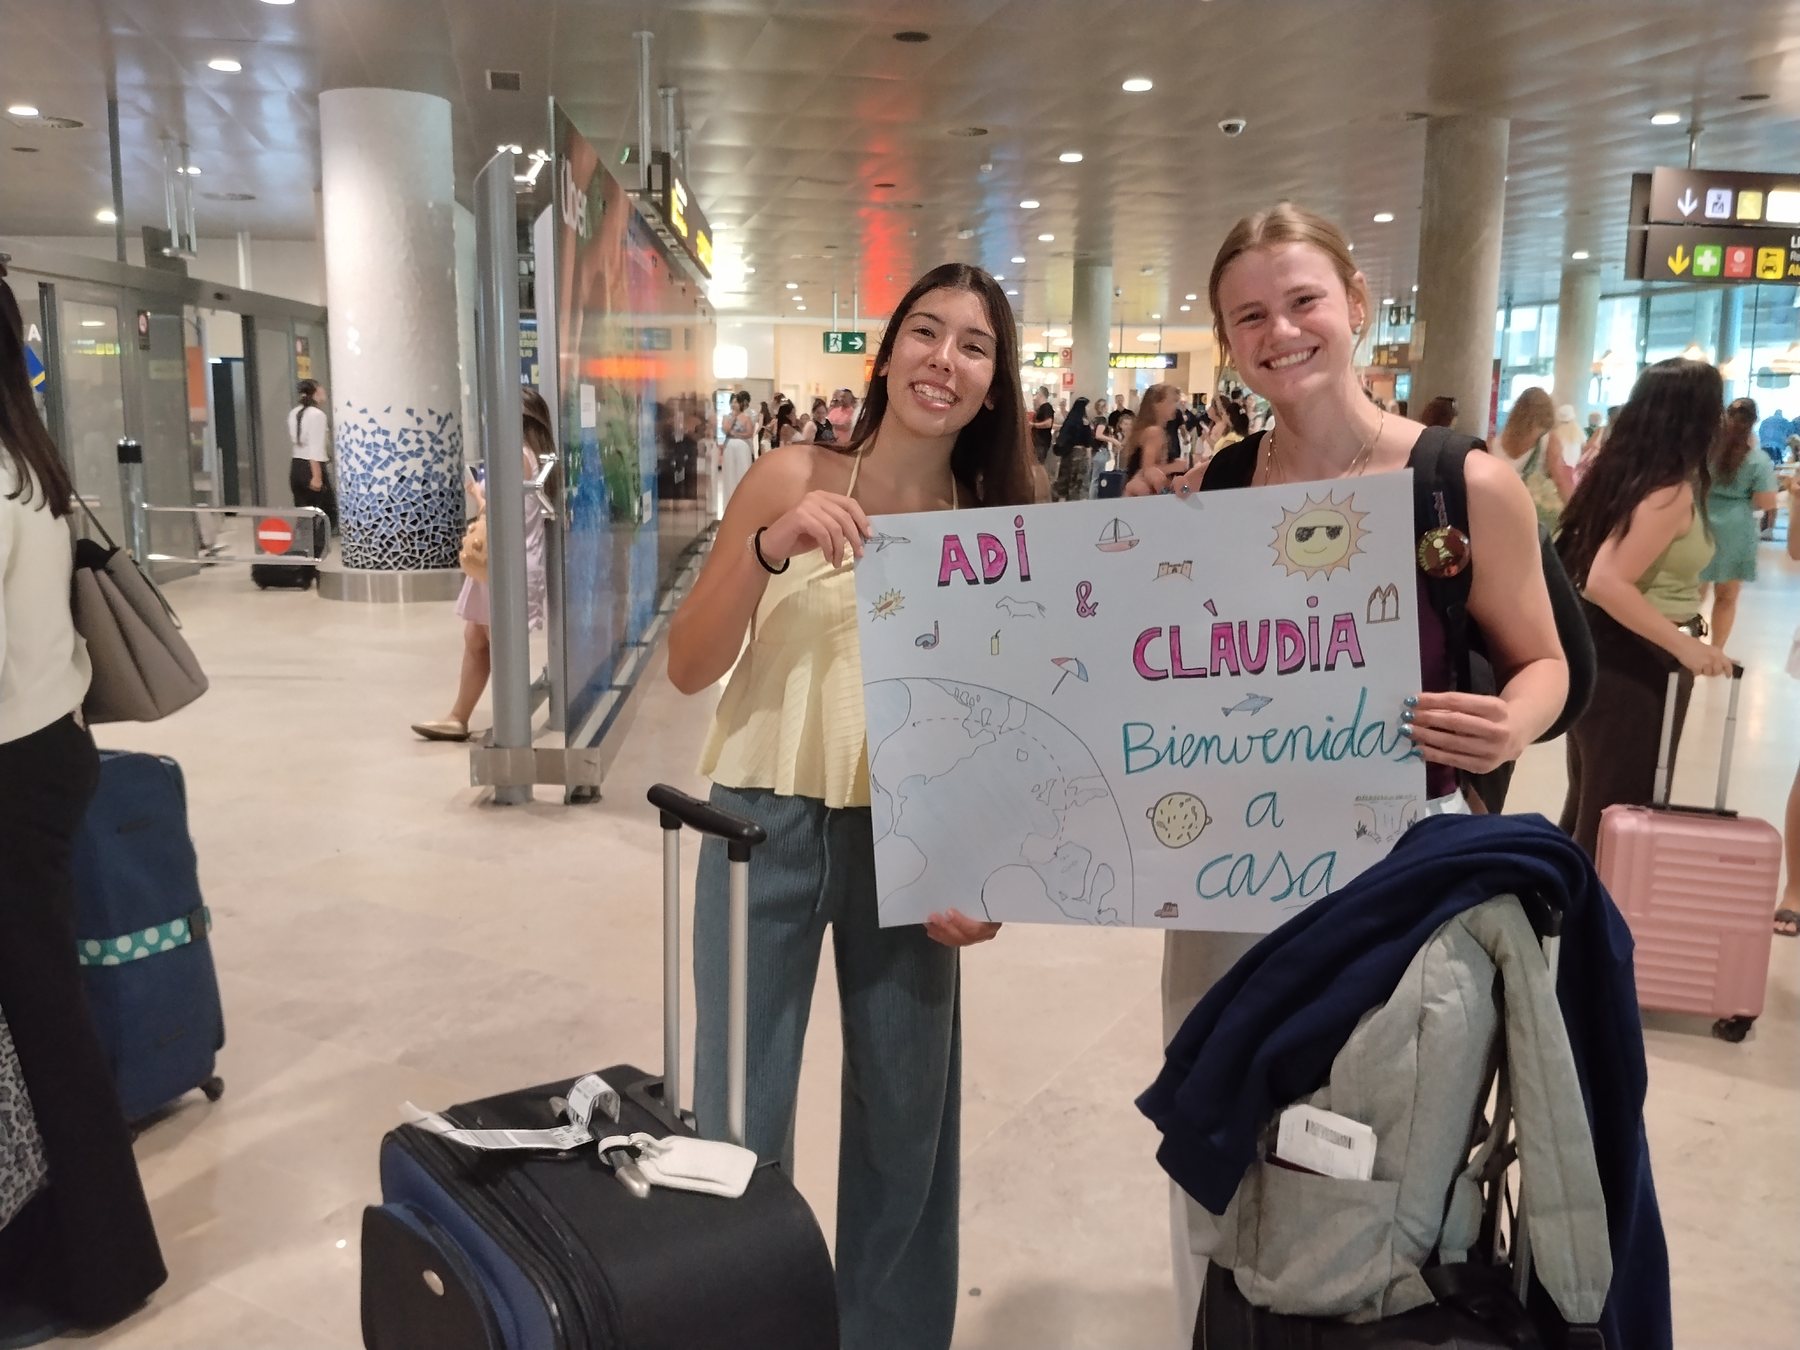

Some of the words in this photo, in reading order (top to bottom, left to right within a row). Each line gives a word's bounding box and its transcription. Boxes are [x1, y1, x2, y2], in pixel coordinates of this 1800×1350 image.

[1075, 580, 1099, 618] &
[1246, 791, 1285, 828] a
[1196, 850, 1337, 902] casa
